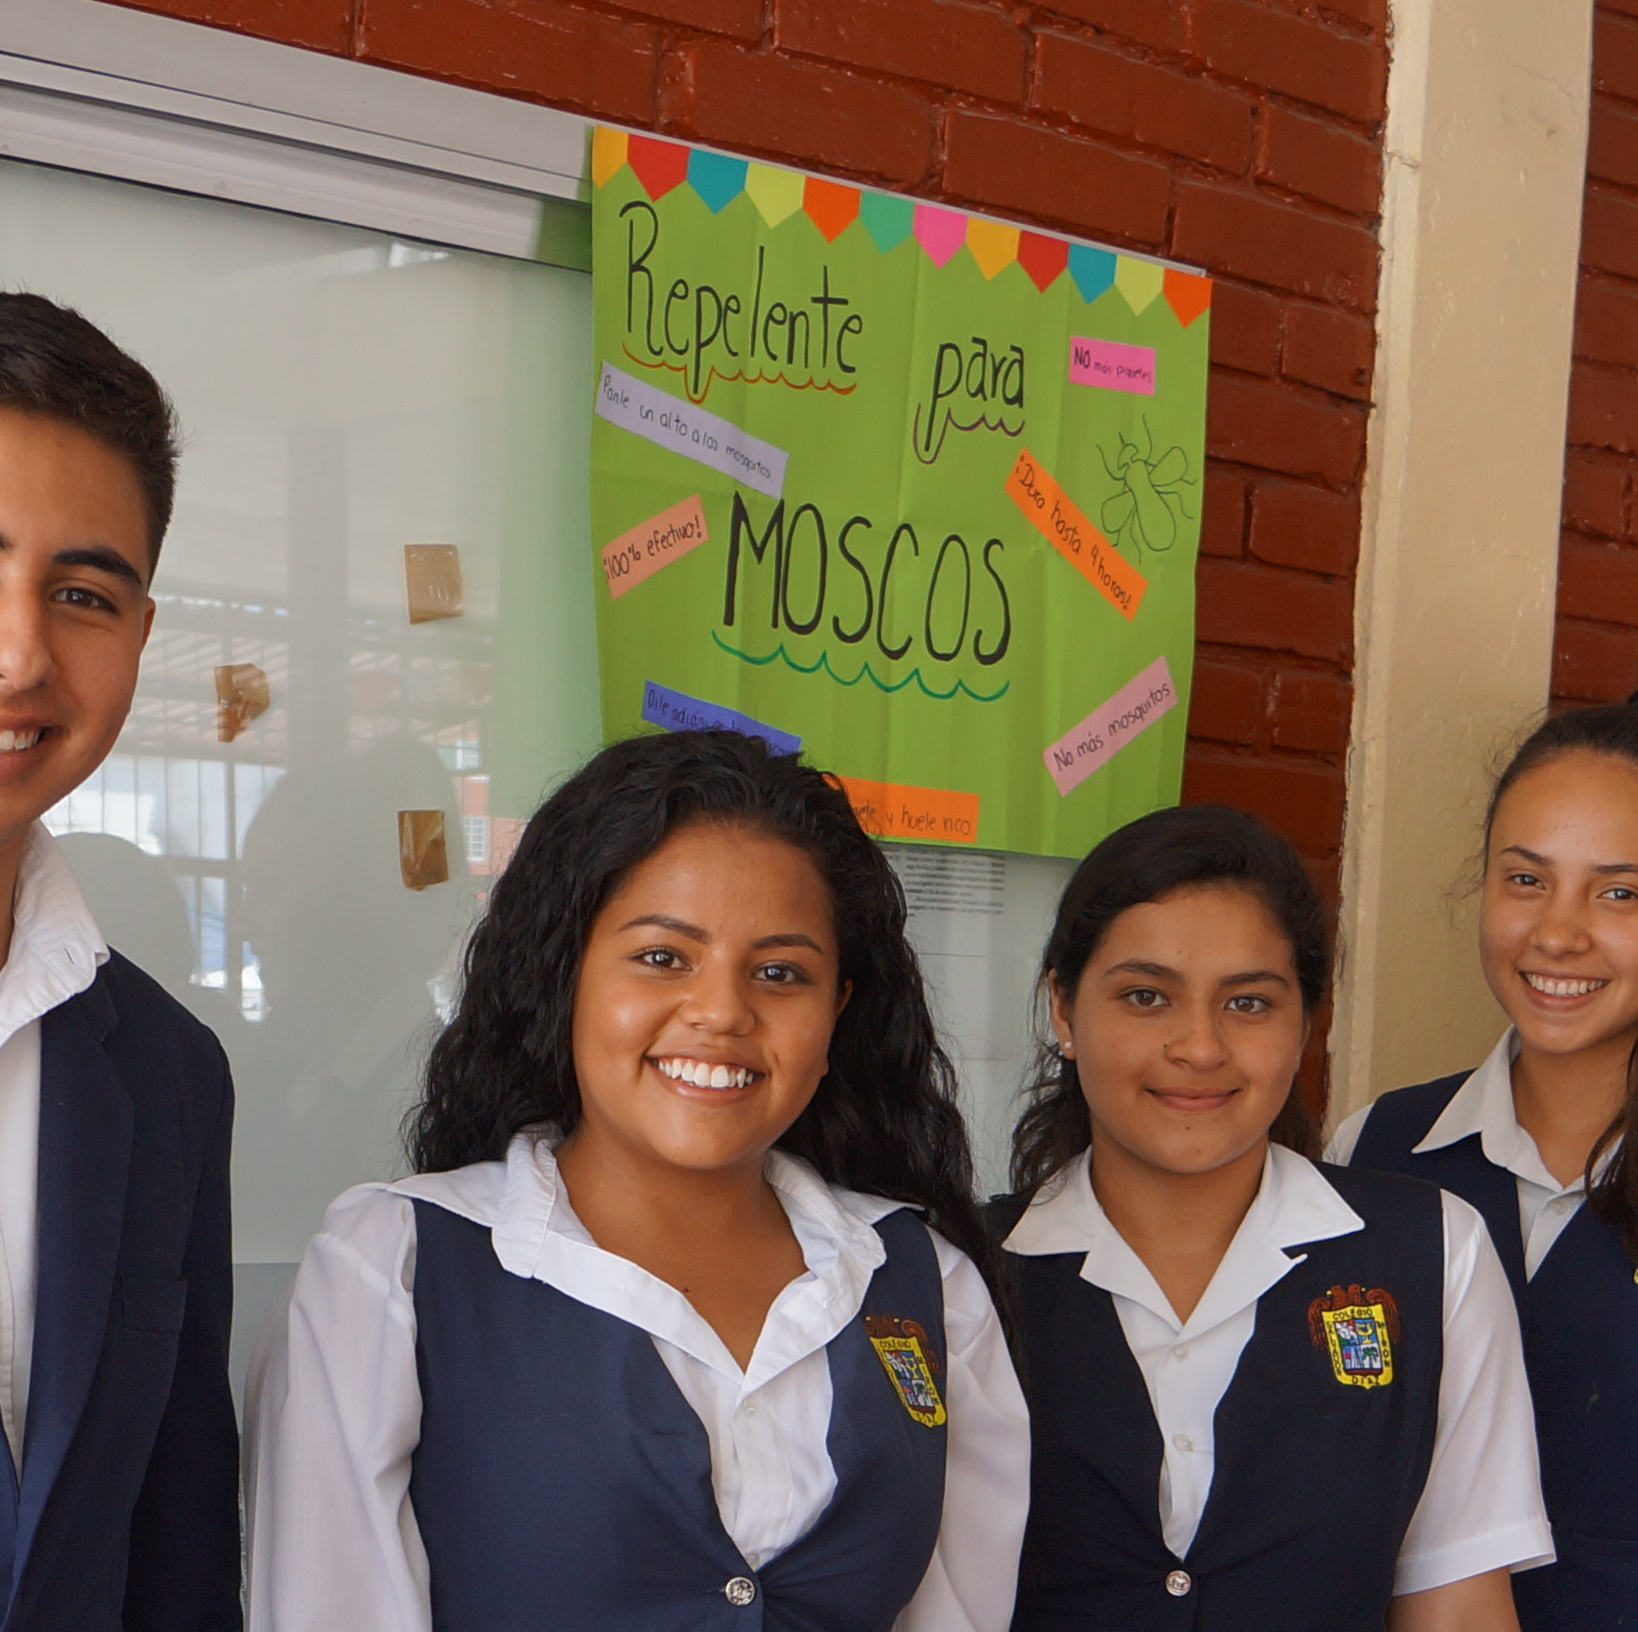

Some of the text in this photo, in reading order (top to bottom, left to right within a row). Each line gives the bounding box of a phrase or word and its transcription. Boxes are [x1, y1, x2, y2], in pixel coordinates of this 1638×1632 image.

[619, 200, 863, 395] Repelente
[924, 336, 1024, 452] para
[1074, 345, 1091, 368] NO
[660, 410, 687, 437] alto
[724, 491, 1011, 665] MOSCOS
[1053, 683, 1170, 772] No más mosquitos
[901, 803, 937, 832] huele
